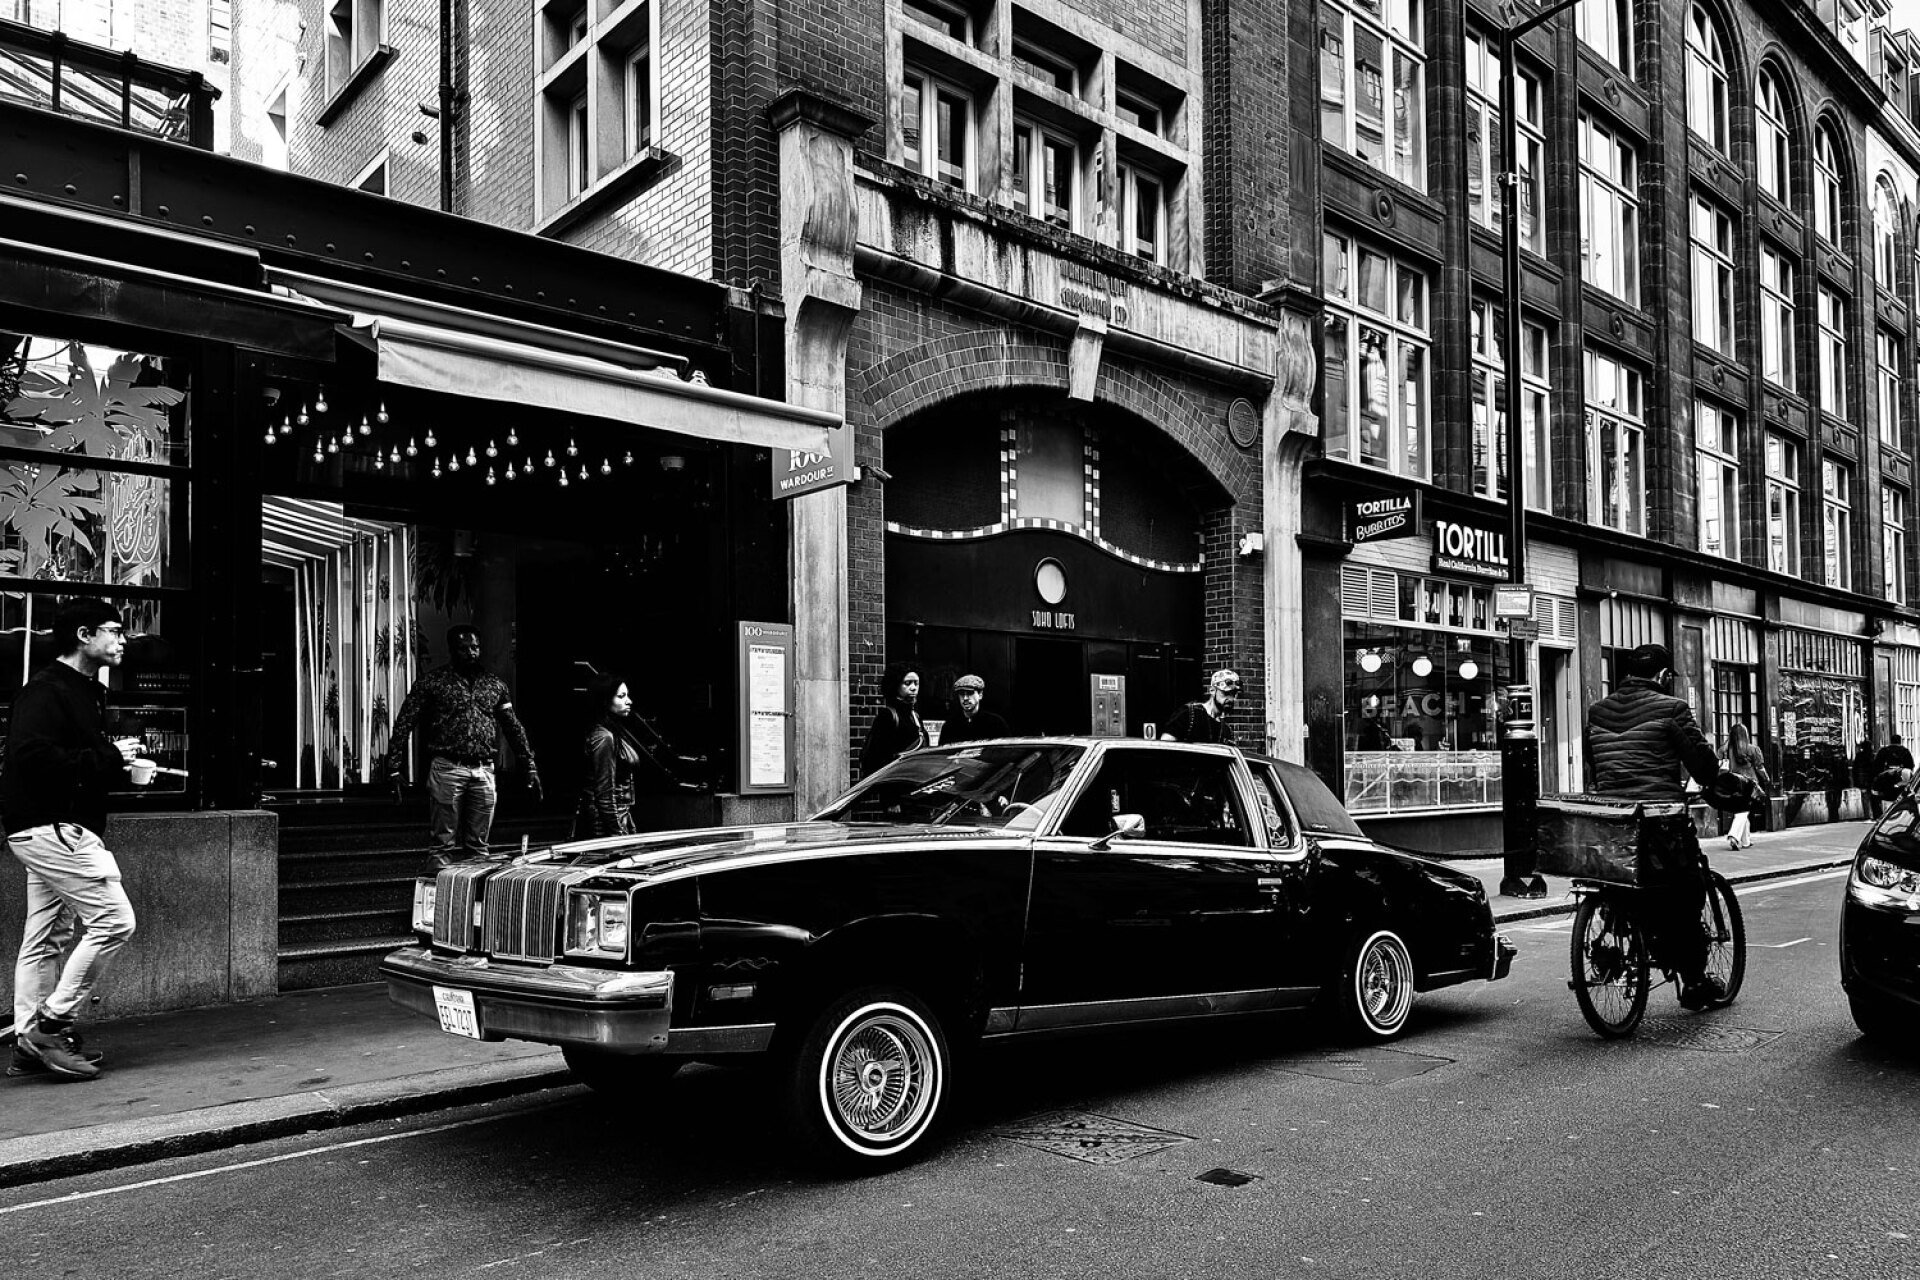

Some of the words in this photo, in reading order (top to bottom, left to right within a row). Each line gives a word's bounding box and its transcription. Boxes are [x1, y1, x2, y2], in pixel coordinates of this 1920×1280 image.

[780, 468, 827, 490] WARDOUR
[1356, 496, 1411, 516] TORTILLA
[1356, 513, 1406, 540] BURRITOS
[1436, 520, 1508, 566] TORTILL
[1438, 557, 1451, 569] Real
[1451, 560, 1477, 573] California
[1032, 610, 1052, 628] SOHO
[1055, 612, 1075, 630] LOFTS
[744, 626, 763, 637] 100
